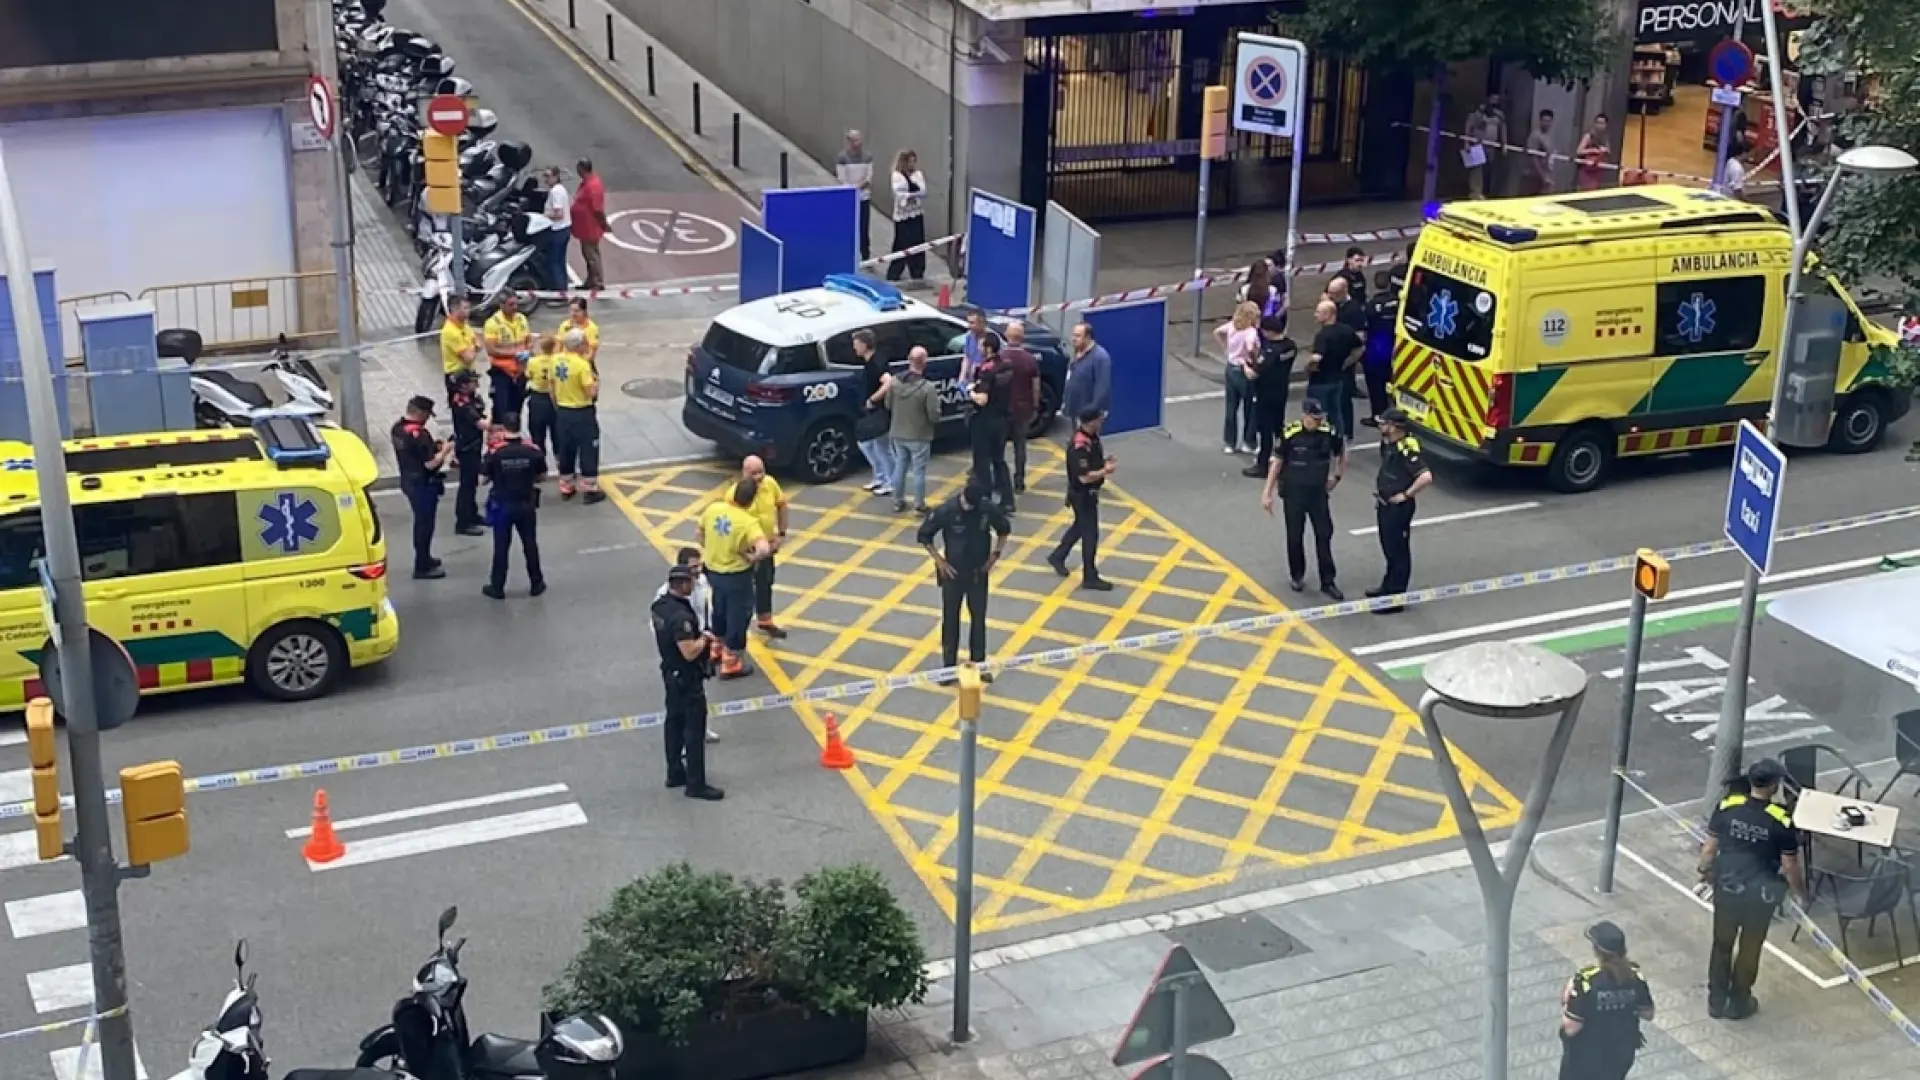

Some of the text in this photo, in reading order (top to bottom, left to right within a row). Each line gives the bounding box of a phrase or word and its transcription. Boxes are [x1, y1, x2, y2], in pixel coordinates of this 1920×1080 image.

[1640, 1, 1762, 33] PERSONAL
[1543, 319, 1566, 332] 112
[1741, 498, 1761, 534] taxi
